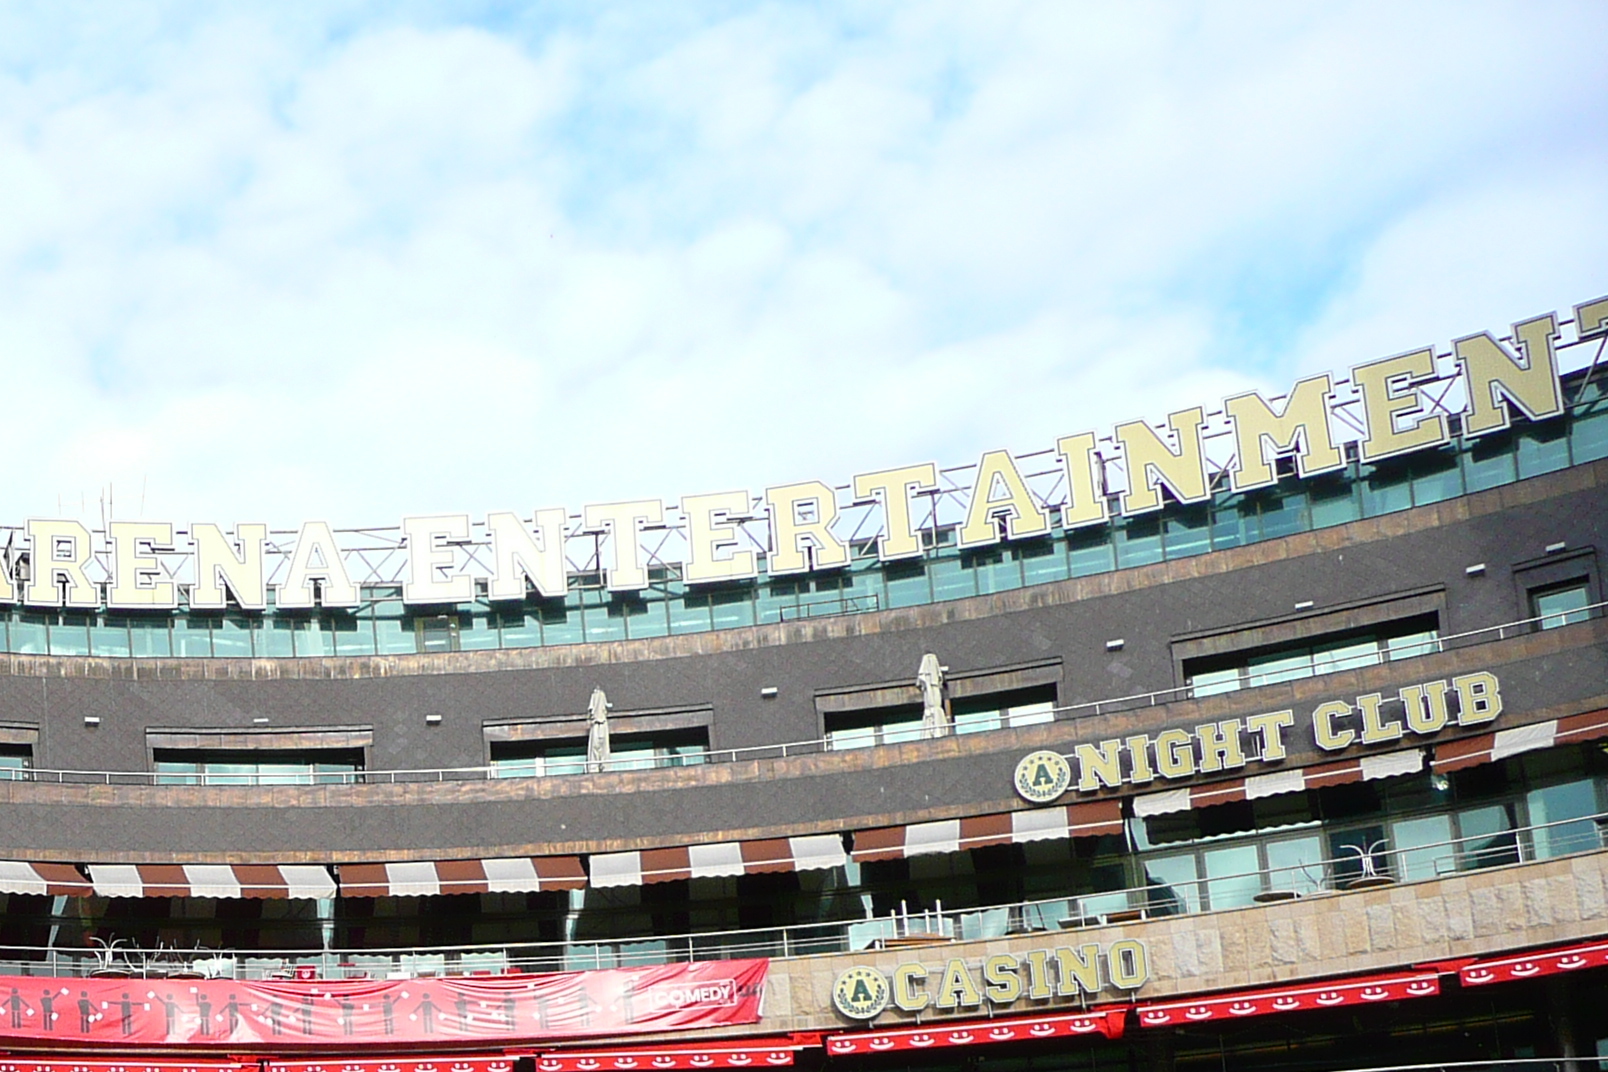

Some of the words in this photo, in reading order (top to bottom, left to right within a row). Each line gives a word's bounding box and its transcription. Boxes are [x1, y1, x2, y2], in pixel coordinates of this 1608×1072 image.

[1076, 709, 1293, 790] NIGHT
[1313, 671, 1502, 751] CLUB
[655, 986, 731, 1005] COMEDY
[892, 938, 1148, 1010] CASINO
